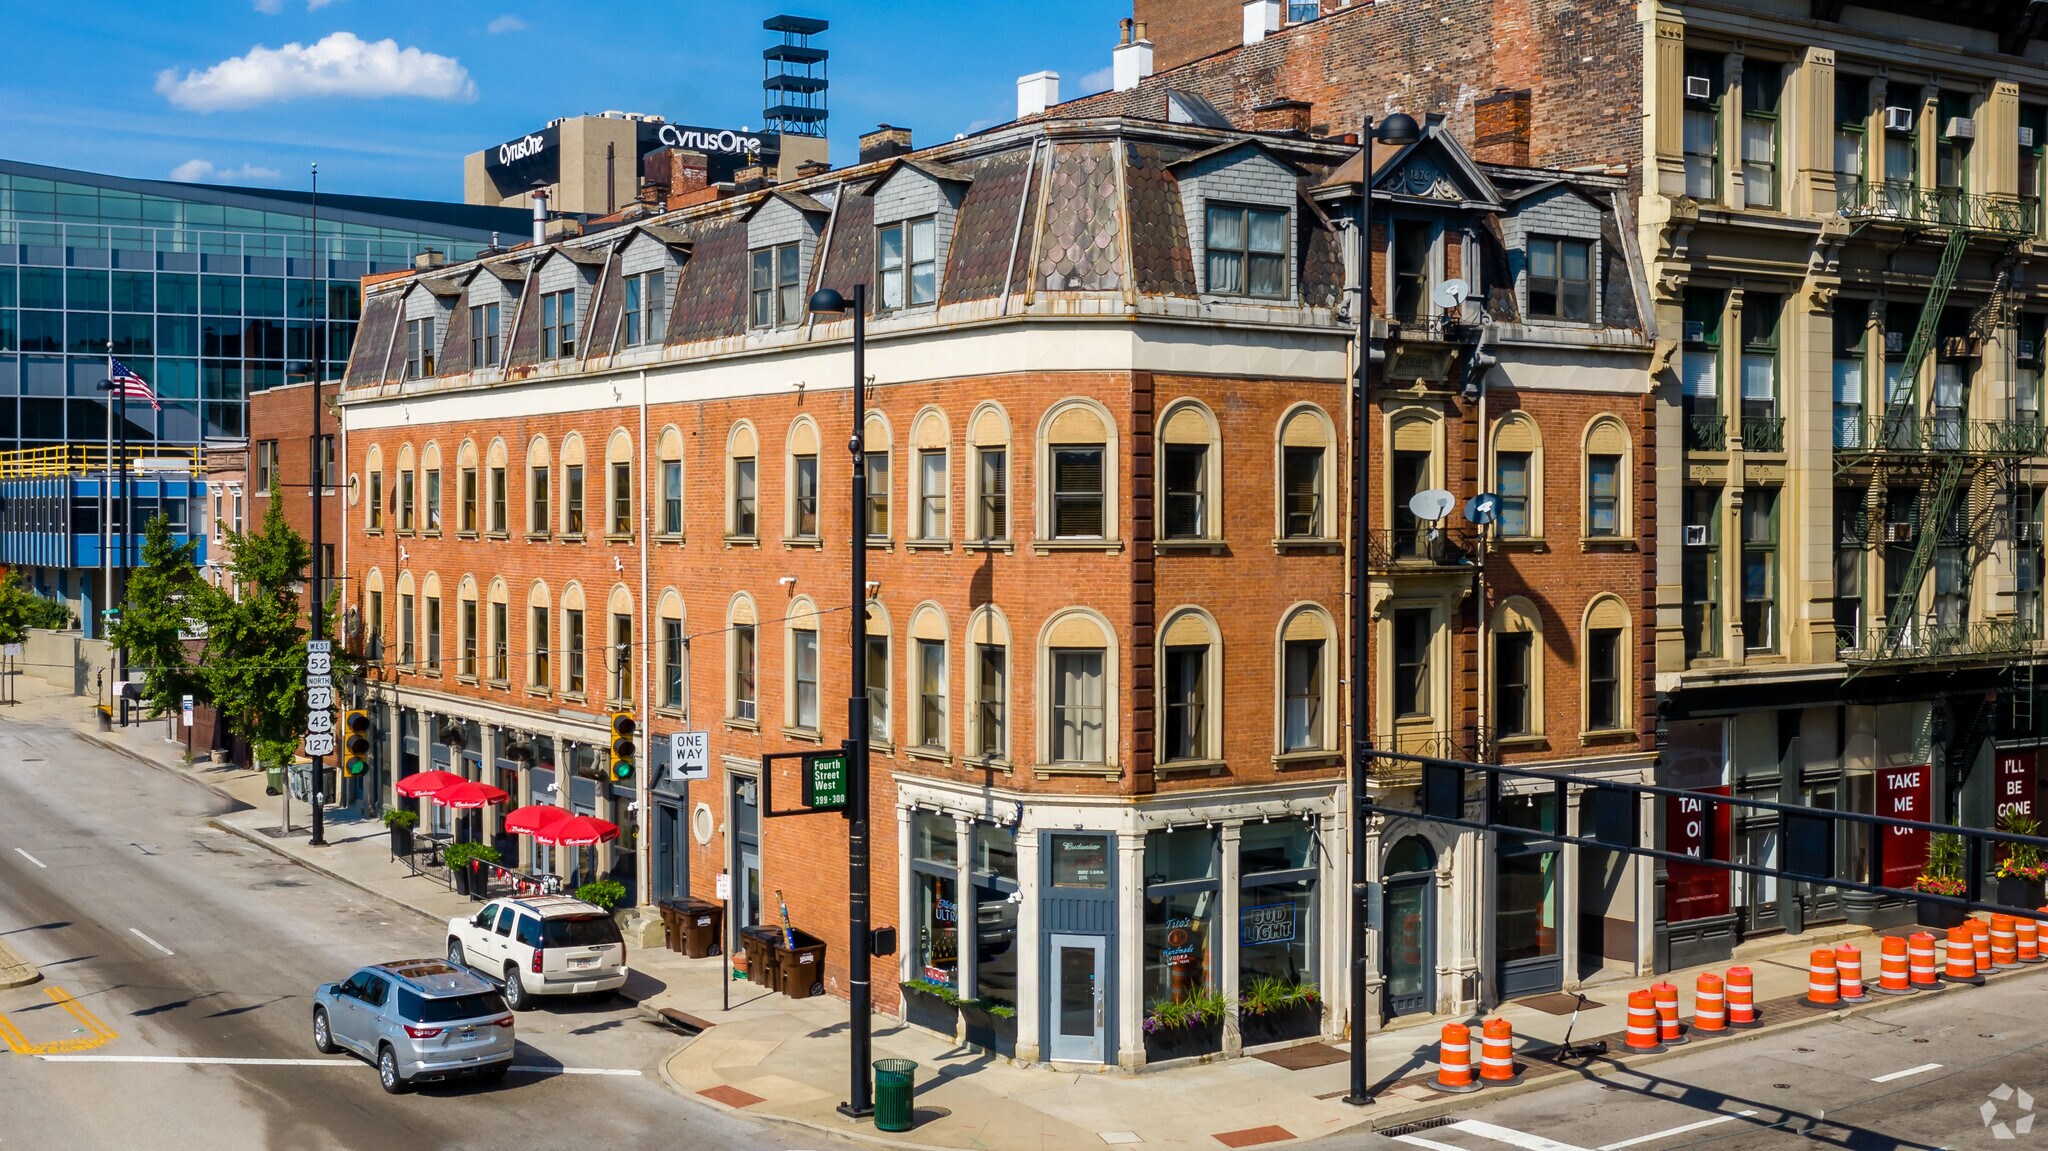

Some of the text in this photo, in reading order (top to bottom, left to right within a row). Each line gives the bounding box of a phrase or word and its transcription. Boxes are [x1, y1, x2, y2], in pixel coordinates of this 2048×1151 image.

[658, 125, 761, 153] CyrusOne
[499, 135, 544, 167] CyrusOne
[1410, 169, 1430, 180] 1876
[309, 642, 329, 650] WEST
[311, 659, 328, 669] 52
[308, 677, 330, 685] NORTH
[311, 693, 327, 705] 27
[311, 716, 328, 727] 42
[309, 740, 329, 751] 127
[677, 735, 702, 747] ONE
[676, 748, 703, 760] WAY
[814, 759, 841, 771] Fourth
[2004, 759, 2025, 774] I'LL
[814, 770, 840, 780] Street
[1887, 772, 1920, 789] TAKE
[815, 780, 836, 791] West
[2007, 780, 2022, 795] BE
[815, 795, 828, 805] 399
[832, 794, 845, 804] 300
[1894, 796, 1913, 812] ME
[1997, 801, 2031, 817] GONE
[1686, 820, 1702, 838] O
[1062, 842, 1100, 851] Budweiser
[1687, 845, 1700, 858] M
[1251, 906, 1287, 925] BUD
[1165, 917, 1191, 930] Tito's
[1243, 920, 1293, 943] LIGHT
